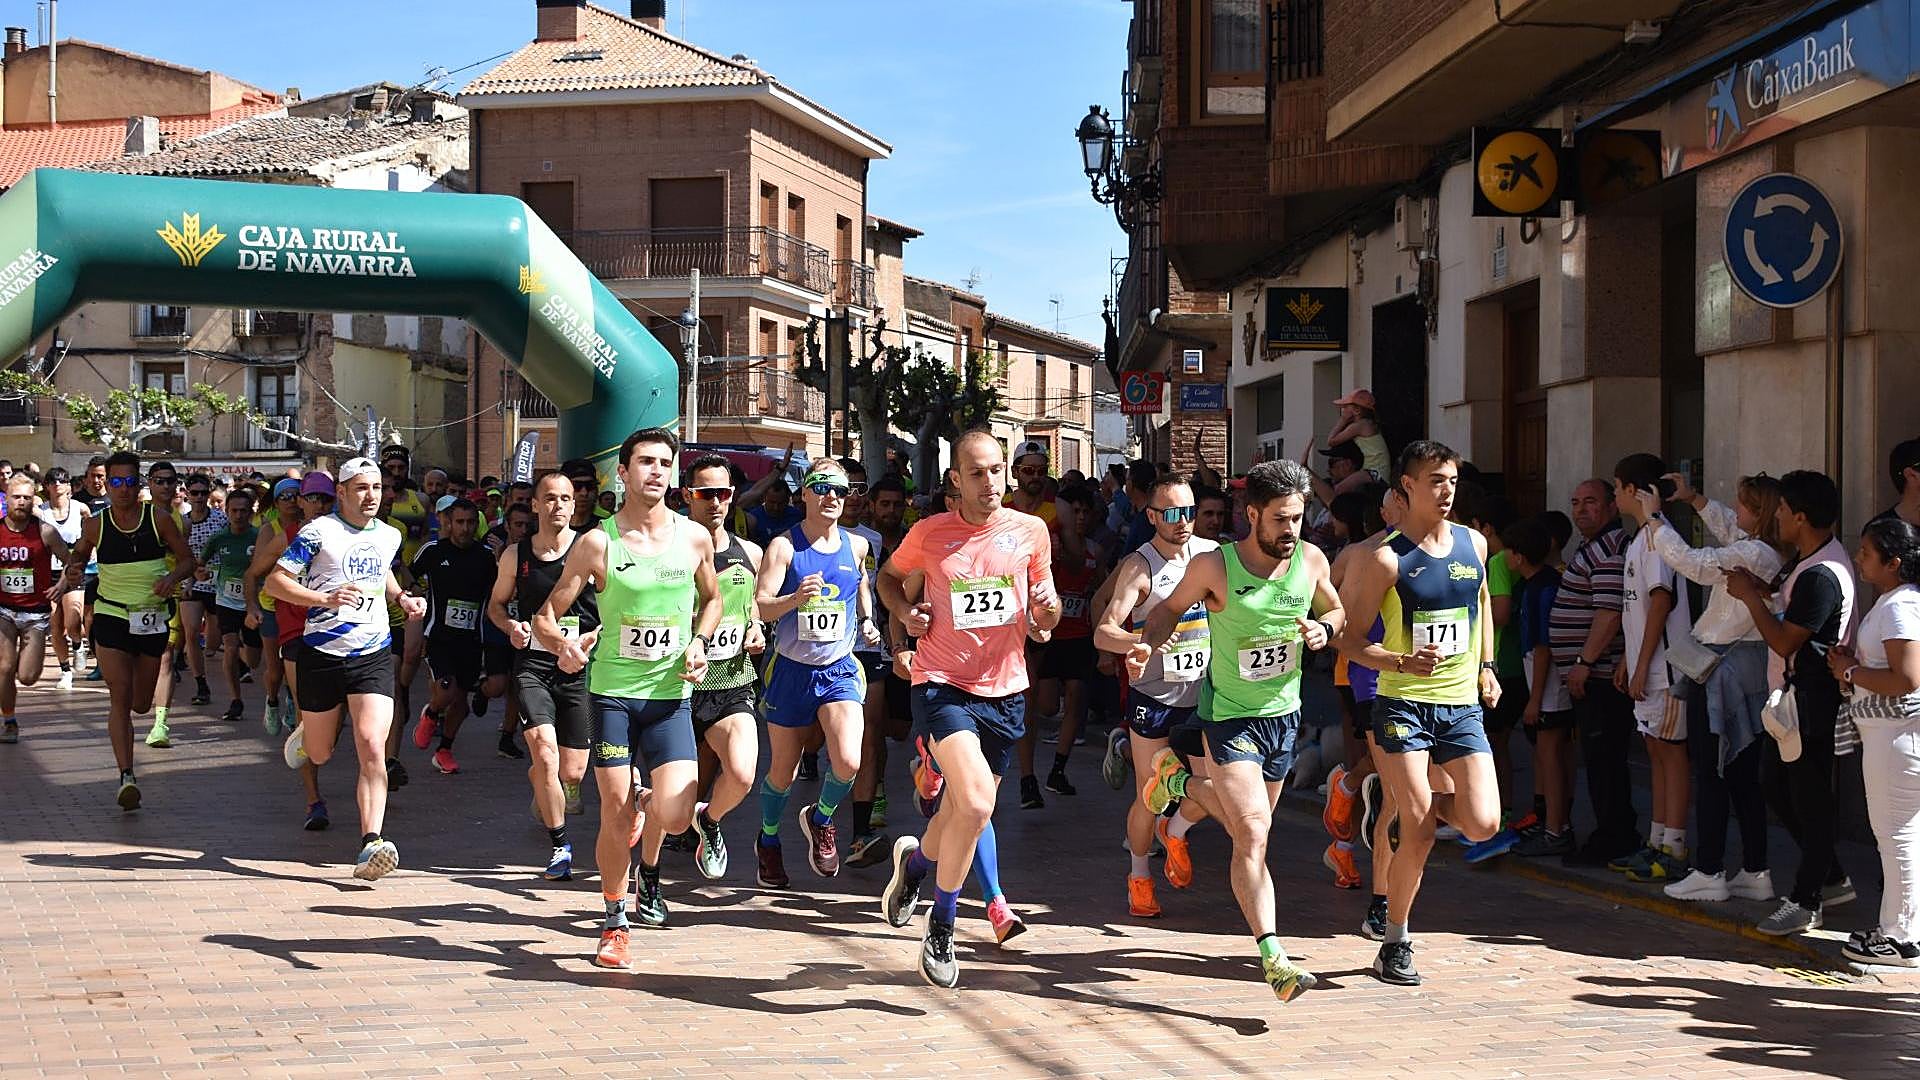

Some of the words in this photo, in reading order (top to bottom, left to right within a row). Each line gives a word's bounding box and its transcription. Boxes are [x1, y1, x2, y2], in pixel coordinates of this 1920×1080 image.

[1747, 19, 1855, 109] CaixaBank
[239, 225, 307, 250] CAJA
[313, 228, 405, 254] RURAL
[238, 249, 276, 272] DE
[285, 252, 417, 278] NAVARRA
[550, 294, 580, 327] CAJA
[577, 321, 619, 365] RURAL
[540, 303, 561, 325] DE
[558, 322, 615, 380] NAVARRA
[1194, 388, 1211, 397] Calle
[518, 440, 531, 473] OPTICA
[222, 466, 256, 474] CLARA
[0, 546, 28, 561] 360
[5, 576, 27, 587] 263
[963, 591, 1005, 613] 232
[142, 613, 156, 626] 61
[451, 608, 474, 621] 250
[807, 613, 839, 630] 107
[629, 629, 671, 648] 204
[1426, 624, 1457, 643] 171
[1173, 652, 1204, 670] 128
[1250, 645, 1288, 668] 233
